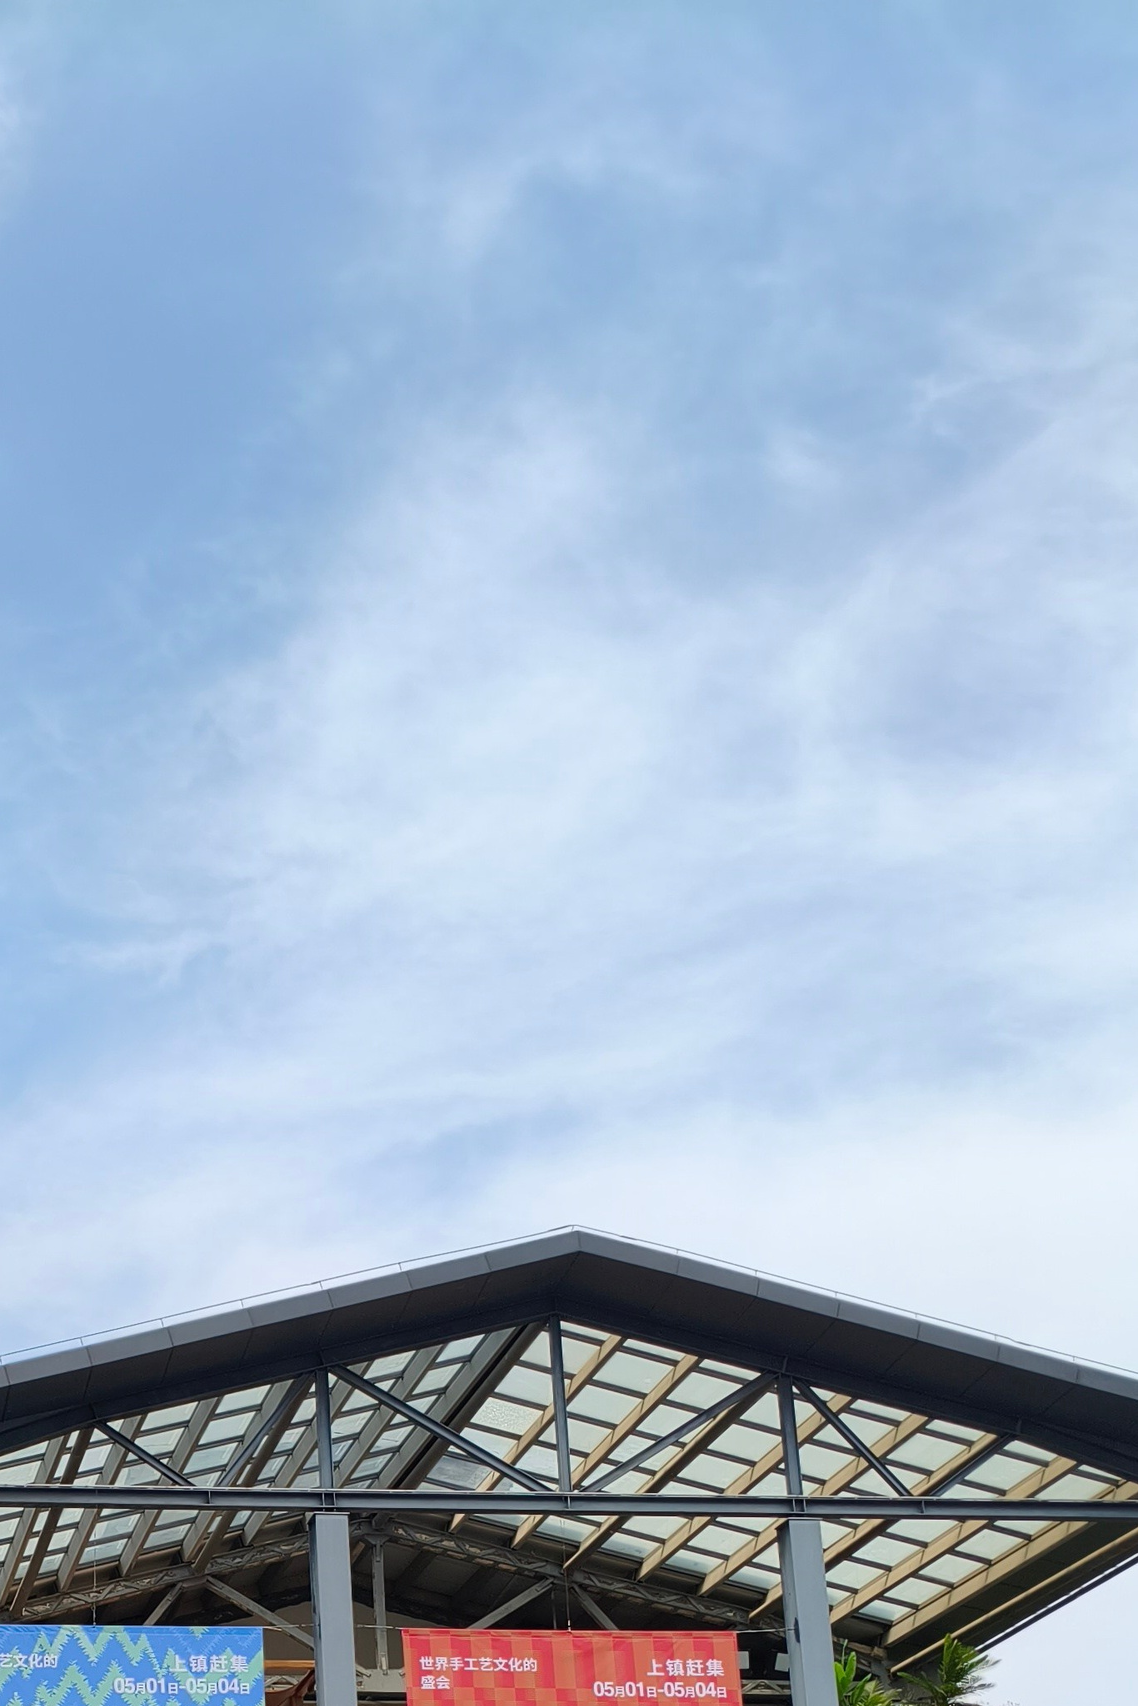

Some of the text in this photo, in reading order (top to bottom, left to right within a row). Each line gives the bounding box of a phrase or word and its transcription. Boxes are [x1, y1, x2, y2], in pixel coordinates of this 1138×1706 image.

[171, 1655, 249, 1673] 上镇赶集
[419, 1656, 537, 1672] 世界手工艺文化的
[647, 1659, 724, 1677] 上镇赶集
[114, 1678, 250, 1695] 05月01日-05月04日
[420, 1675, 450, 1690] 盛会
[593, 1681, 727, 1698] 05月01日-05月04日
